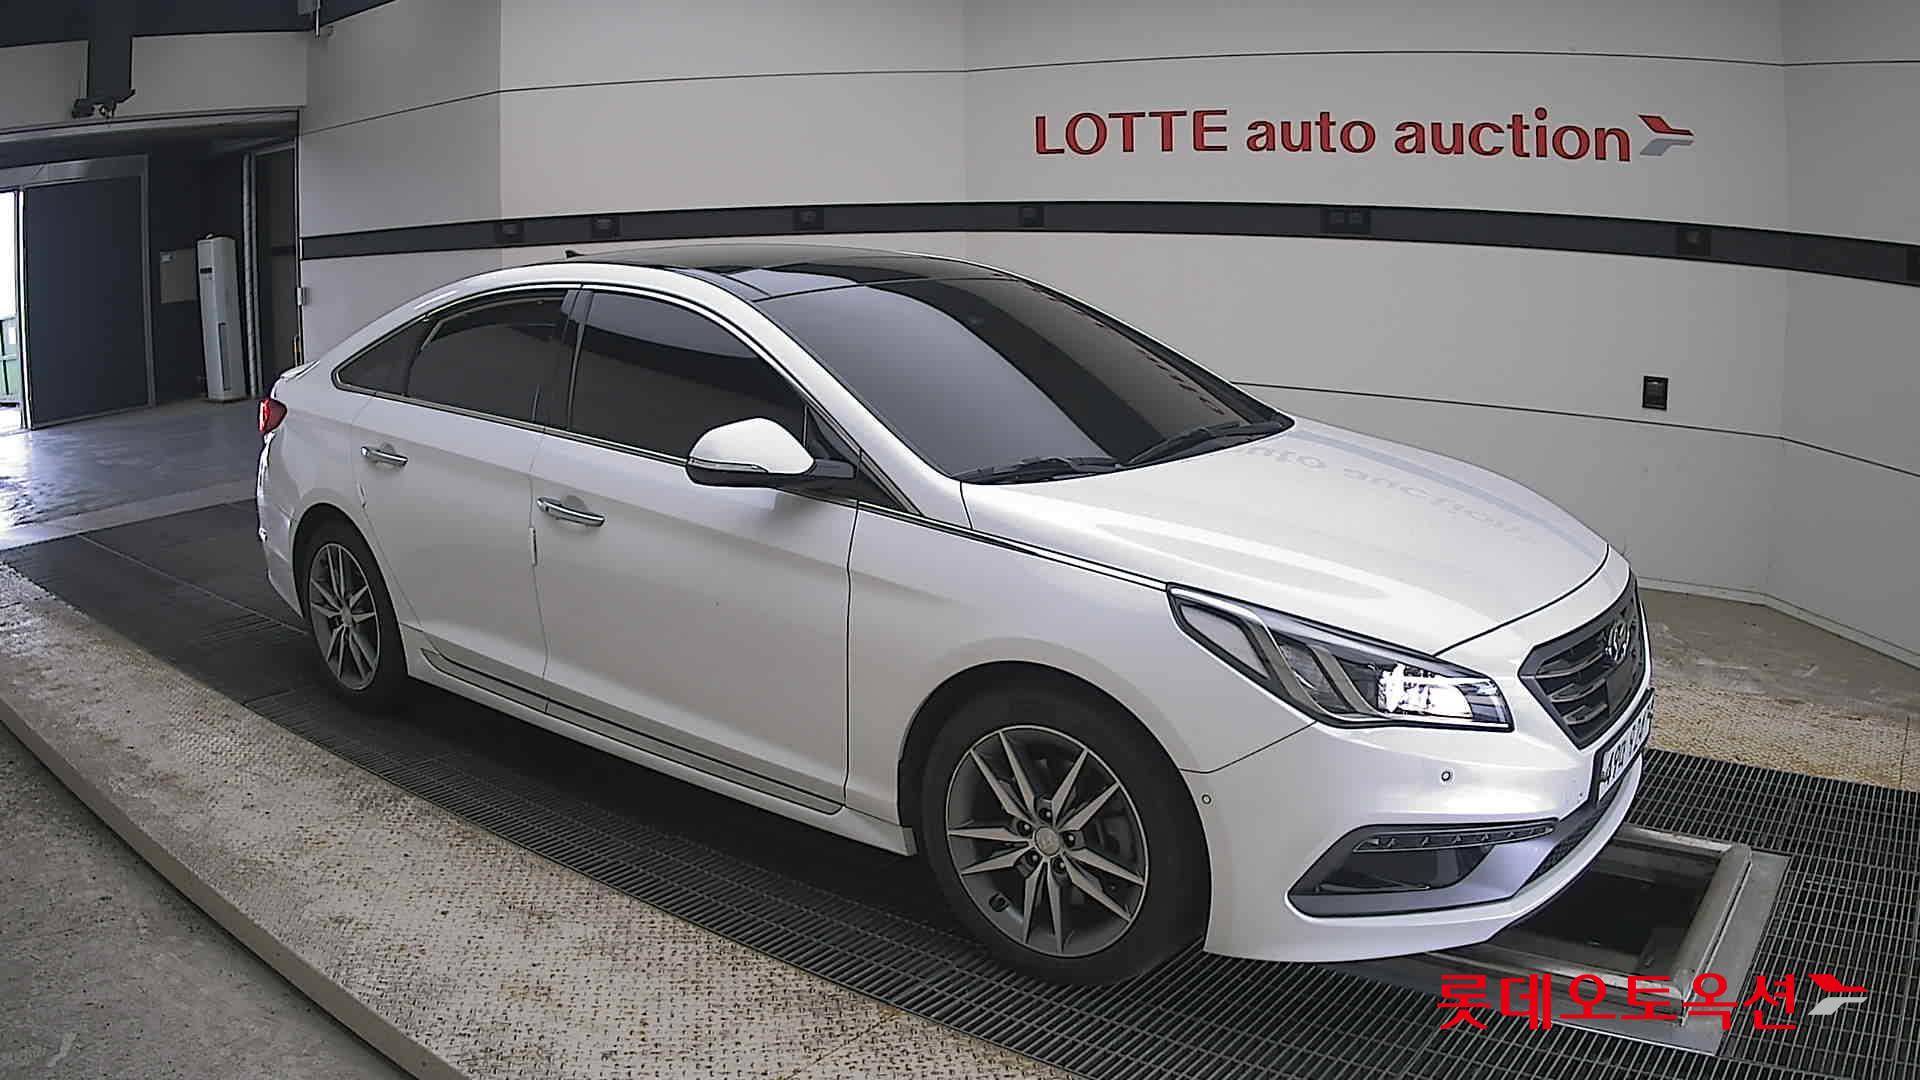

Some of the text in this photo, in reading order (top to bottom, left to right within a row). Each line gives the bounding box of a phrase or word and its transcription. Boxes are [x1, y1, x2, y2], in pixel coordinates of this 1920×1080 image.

[1035, 107, 1631, 162] LOTTE auto auction
